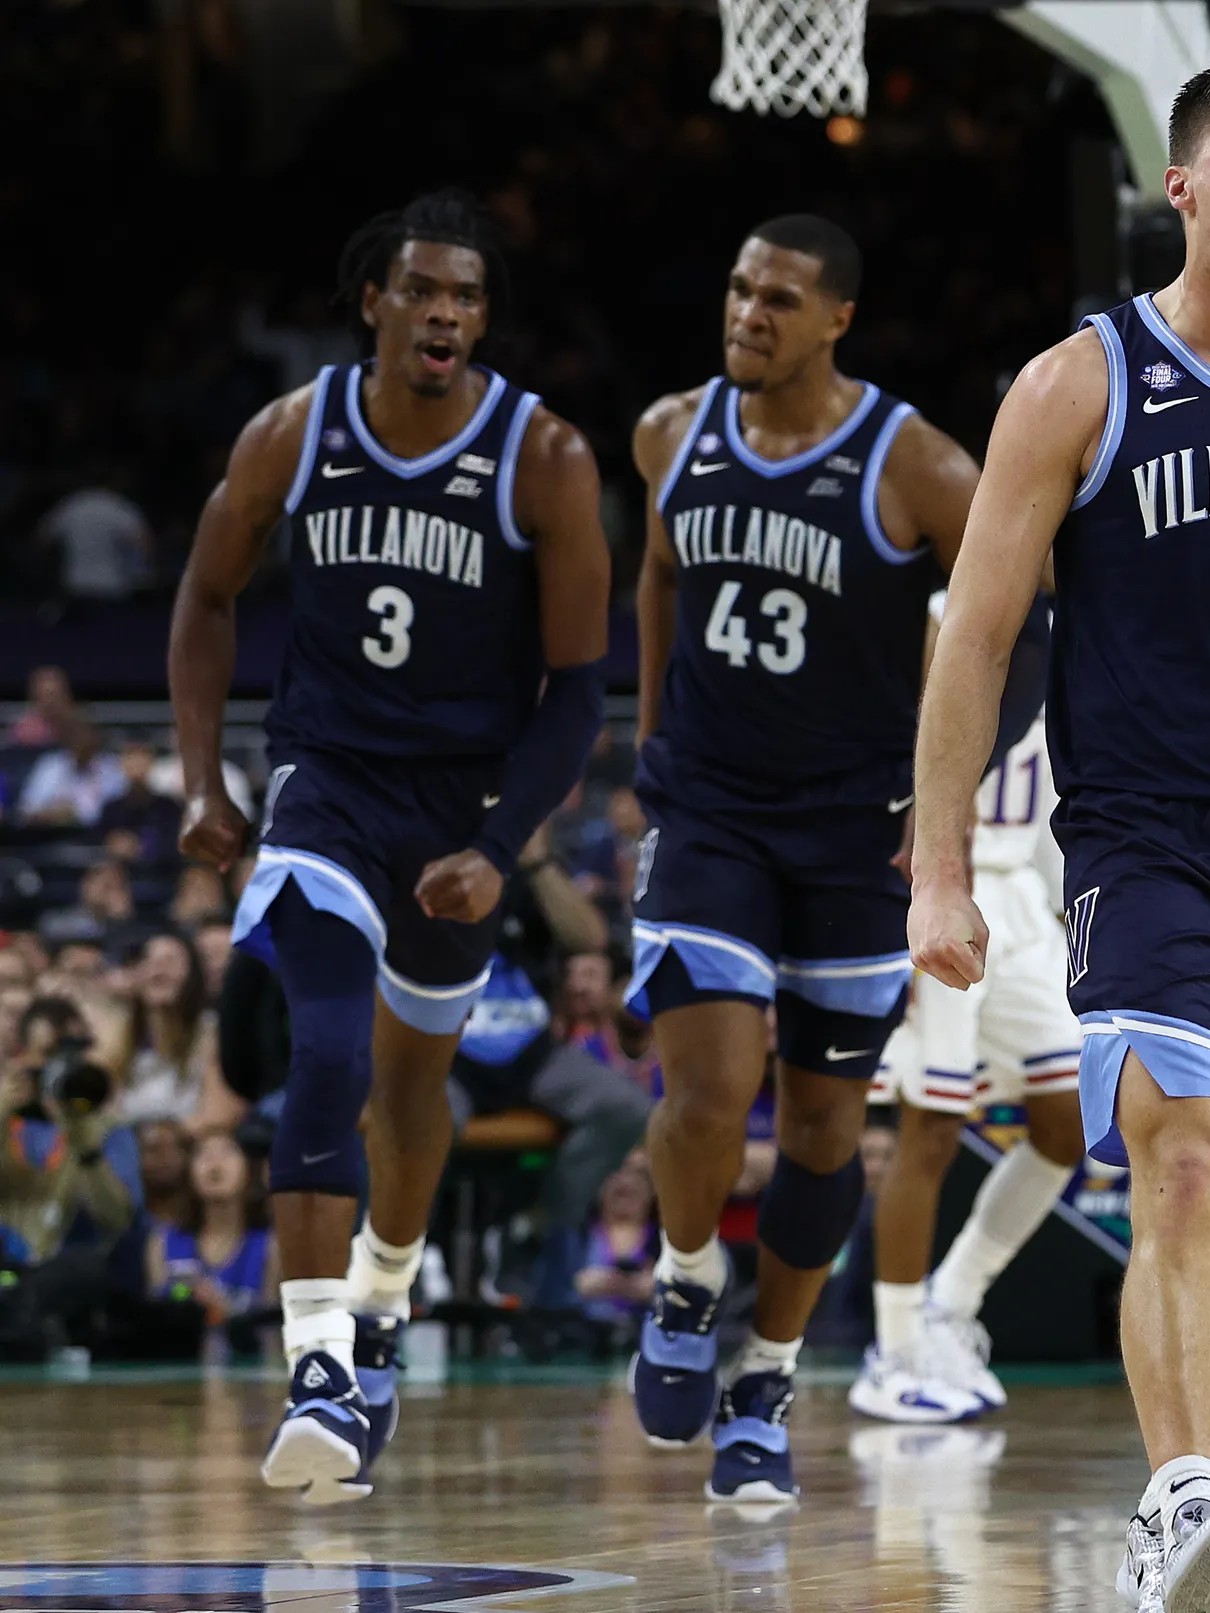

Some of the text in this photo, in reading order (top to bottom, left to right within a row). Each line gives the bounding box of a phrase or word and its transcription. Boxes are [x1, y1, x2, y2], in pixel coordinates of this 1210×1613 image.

[1151, 375, 1172, 385] FOUR
[1152, 368, 1172, 376] FINAL
[306, 505, 484, 588] VILLANOVA
[674, 504, 842, 597] VILLANOVA
[362, 585, 414, 669] 3
[704, 580, 808, 675] 43
